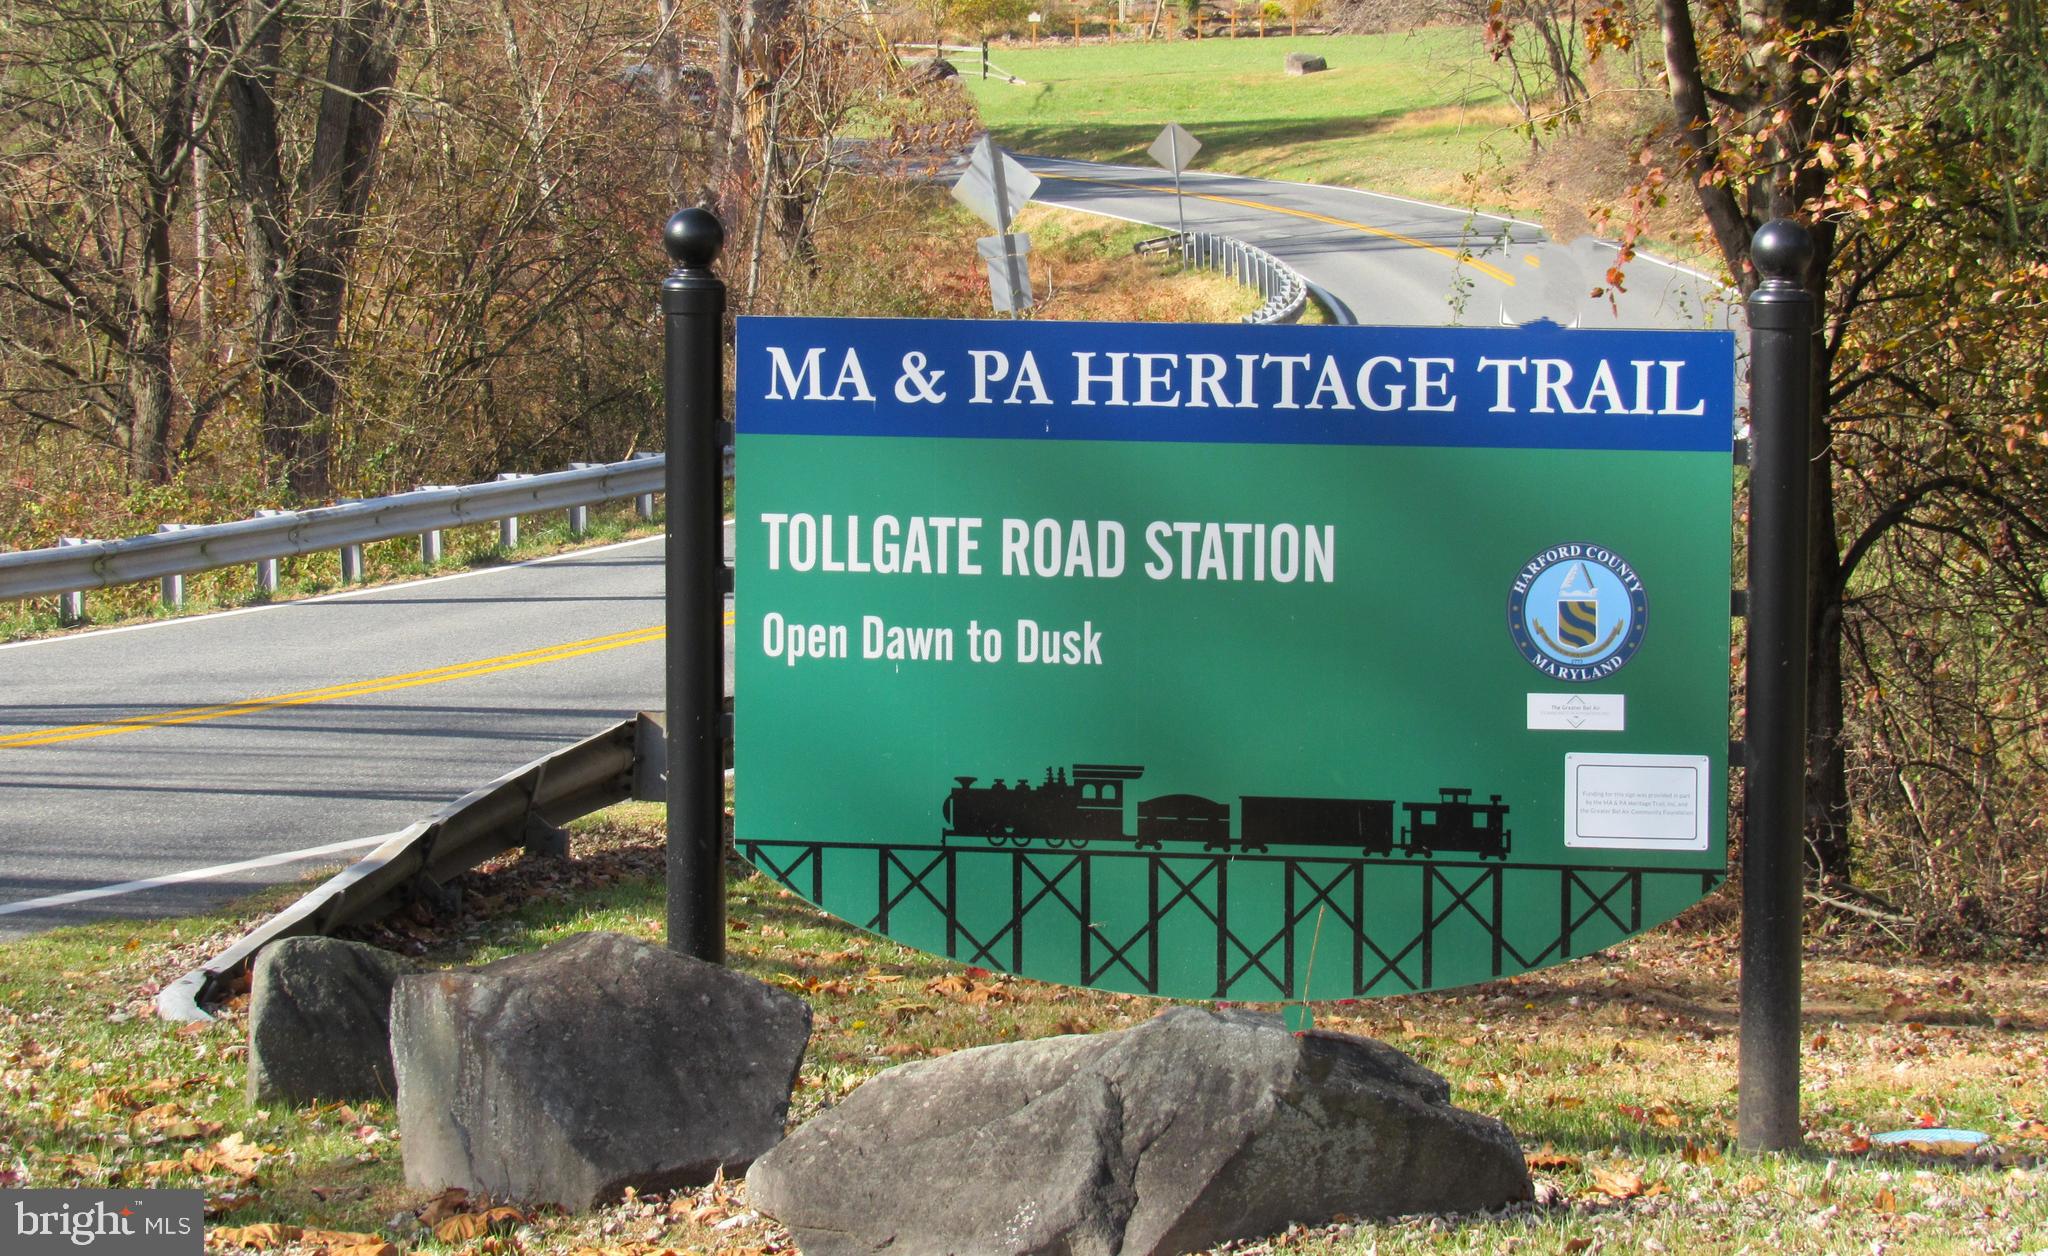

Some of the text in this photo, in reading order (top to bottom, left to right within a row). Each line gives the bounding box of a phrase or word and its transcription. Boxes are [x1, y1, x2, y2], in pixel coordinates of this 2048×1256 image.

[765, 347, 1705, 416] MA & PA HERITAGE TRAIL
[761, 513, 1335, 583] TOLLGATE ROAD STATION
[1514, 545, 1643, 594] HARFORD COUNTY
[763, 613, 1102, 667] Open Dawn to Dusk
[1532, 654, 1622, 680] MARYLAND
